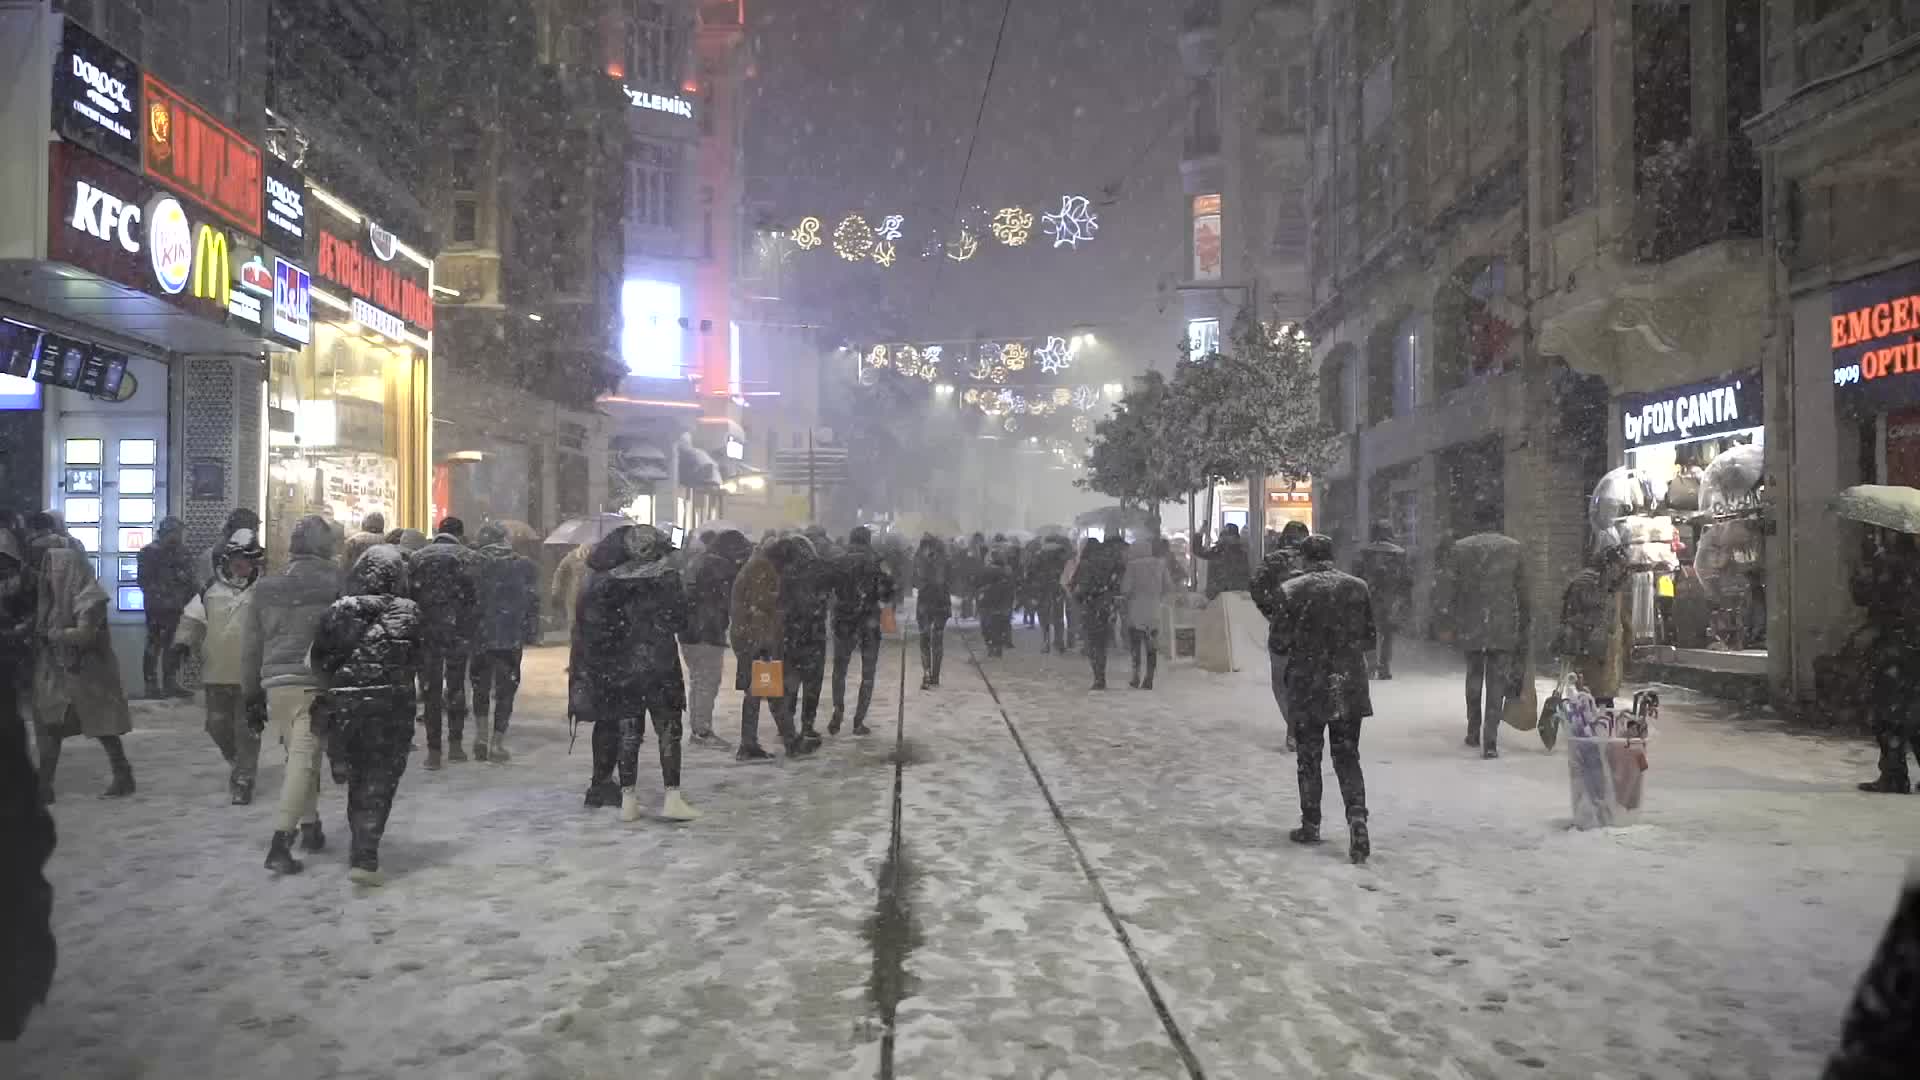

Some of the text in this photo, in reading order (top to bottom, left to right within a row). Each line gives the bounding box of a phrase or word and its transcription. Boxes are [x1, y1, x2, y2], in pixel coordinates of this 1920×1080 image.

[71, 180, 141, 253] KFC
[275, 276, 310, 320] D&R
[1833, 364, 1860, 387] 1909
[1676, 386, 1738, 438] ÇANTA
